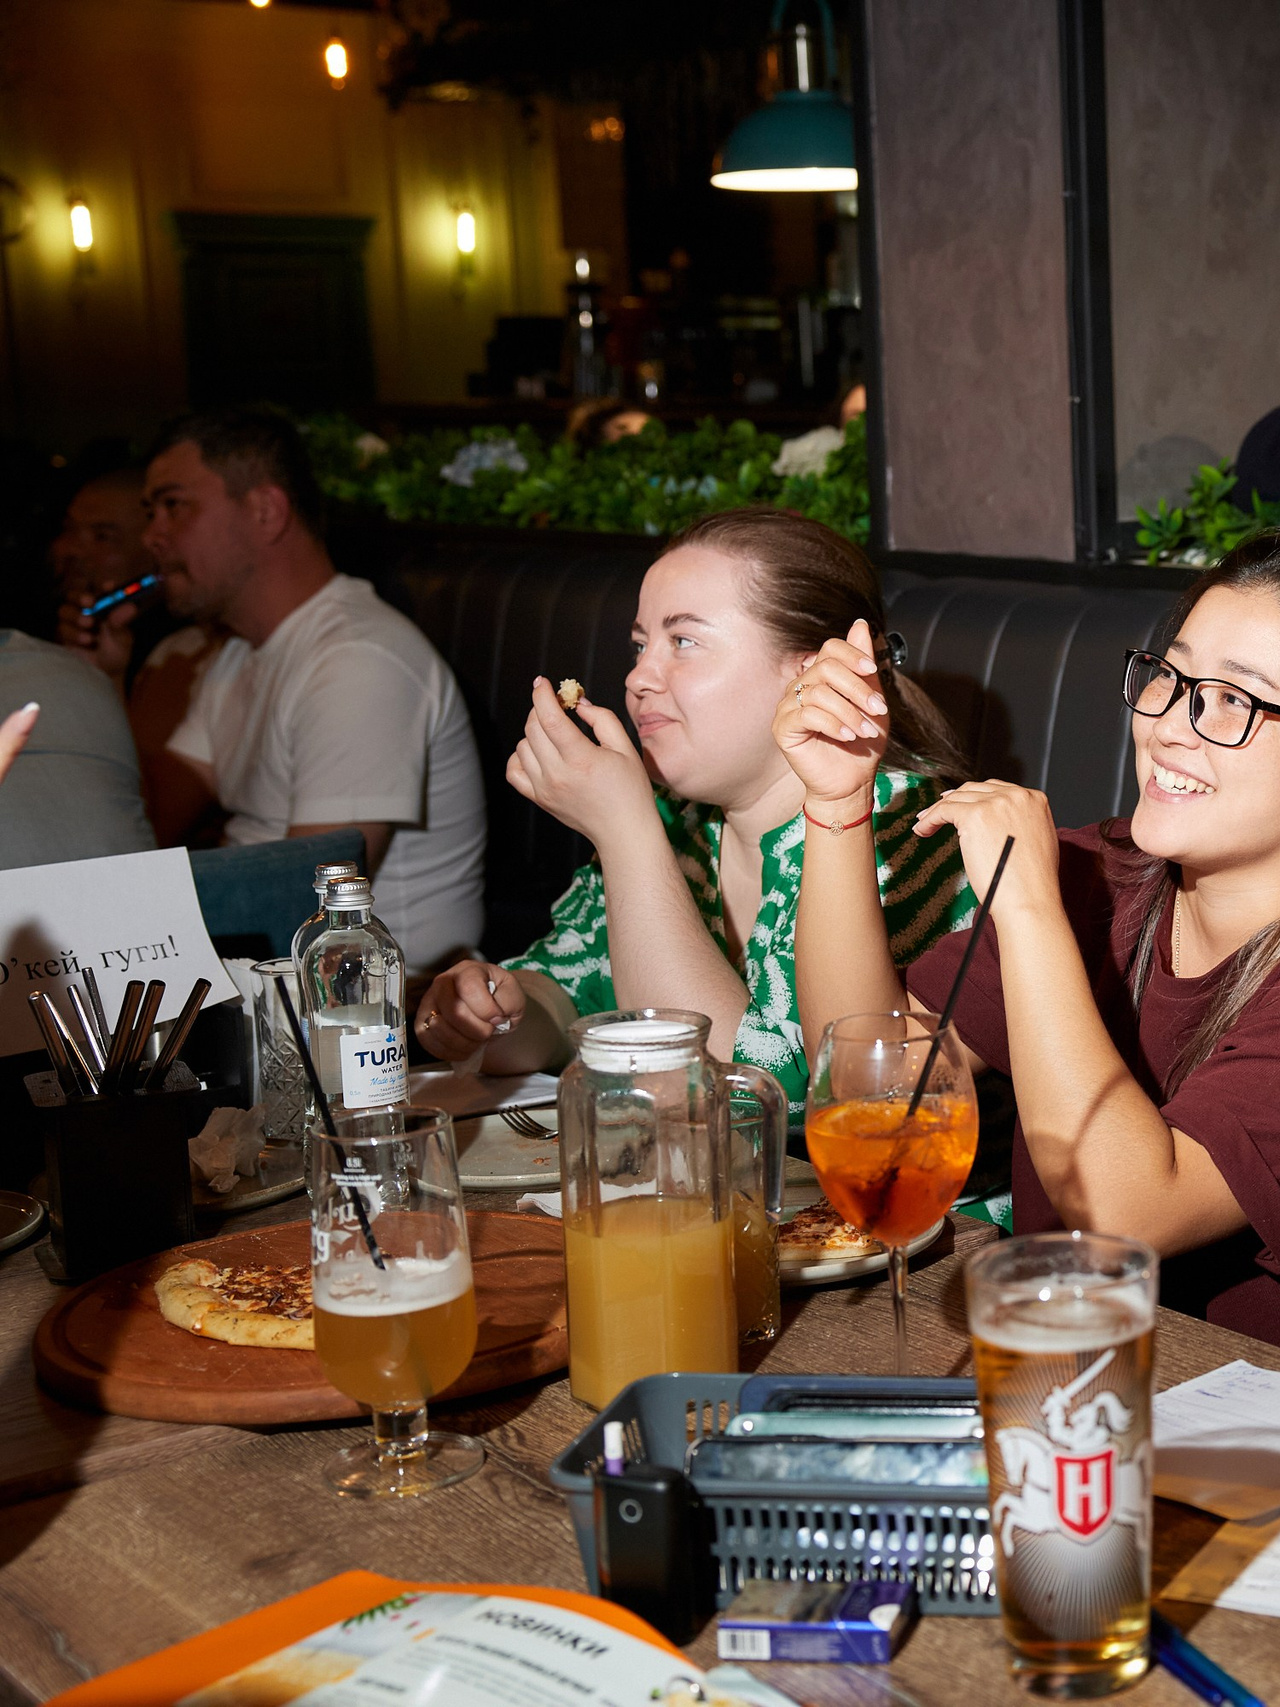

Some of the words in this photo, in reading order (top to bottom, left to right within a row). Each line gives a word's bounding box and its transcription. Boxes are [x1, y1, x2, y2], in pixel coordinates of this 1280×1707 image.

[99, 935, 180, 972] гугл!
[354, 1043, 407, 1068] TURA
[381, 1064, 403, 1075] WATER
